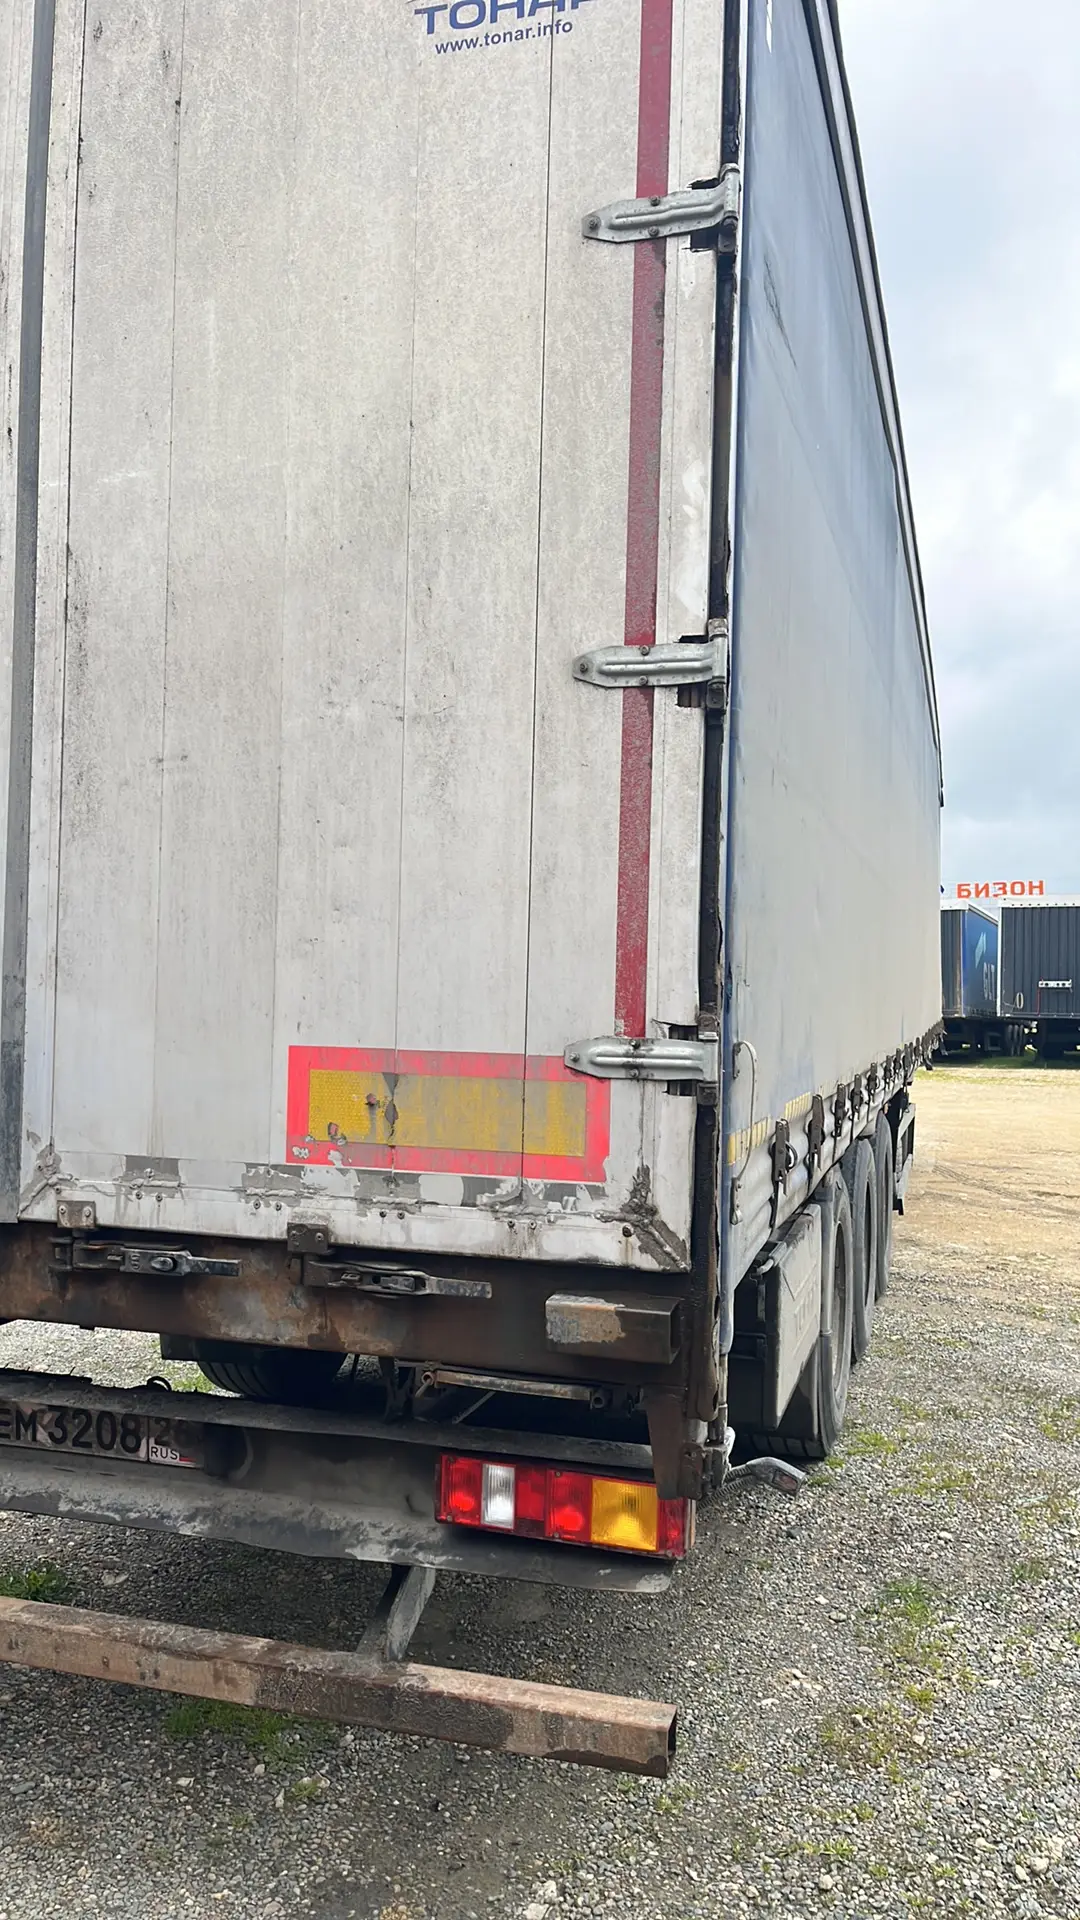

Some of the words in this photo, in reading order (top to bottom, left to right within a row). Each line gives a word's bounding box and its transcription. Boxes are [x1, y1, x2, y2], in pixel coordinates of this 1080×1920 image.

[435, 19, 573, 54] www.tonar.info
[957, 880, 1044, 899] БИЗОН
[150, 1446, 178, 1460] RUS
